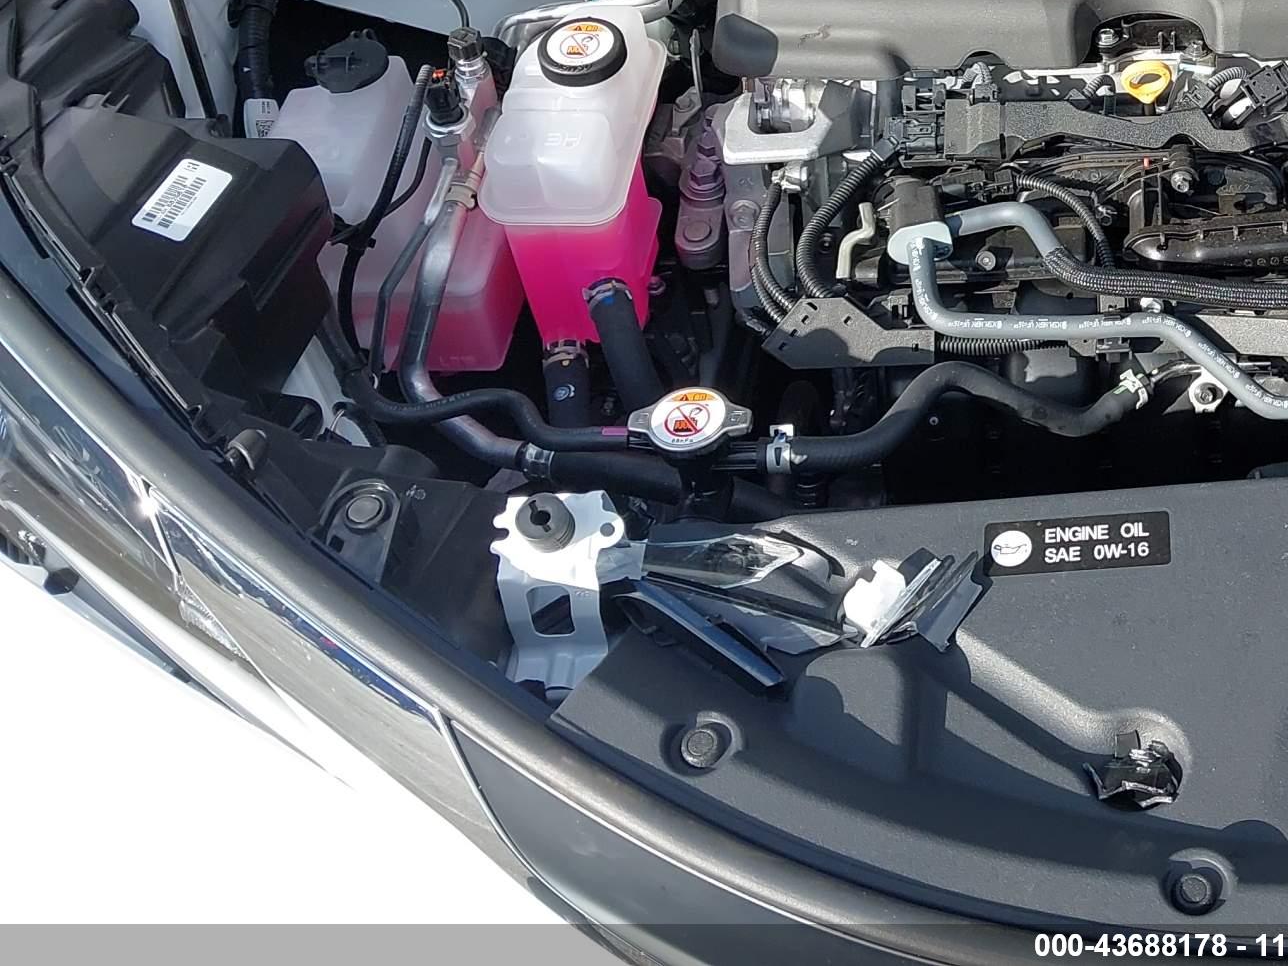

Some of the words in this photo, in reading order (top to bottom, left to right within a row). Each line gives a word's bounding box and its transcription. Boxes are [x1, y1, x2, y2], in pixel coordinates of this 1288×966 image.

[1044, 525, 1110, 543] ENGINE
[1120, 523, 1149, 538] OIL
[1044, 547, 1081, 563] SAE
[1094, 542, 1149, 560] 0W-16
